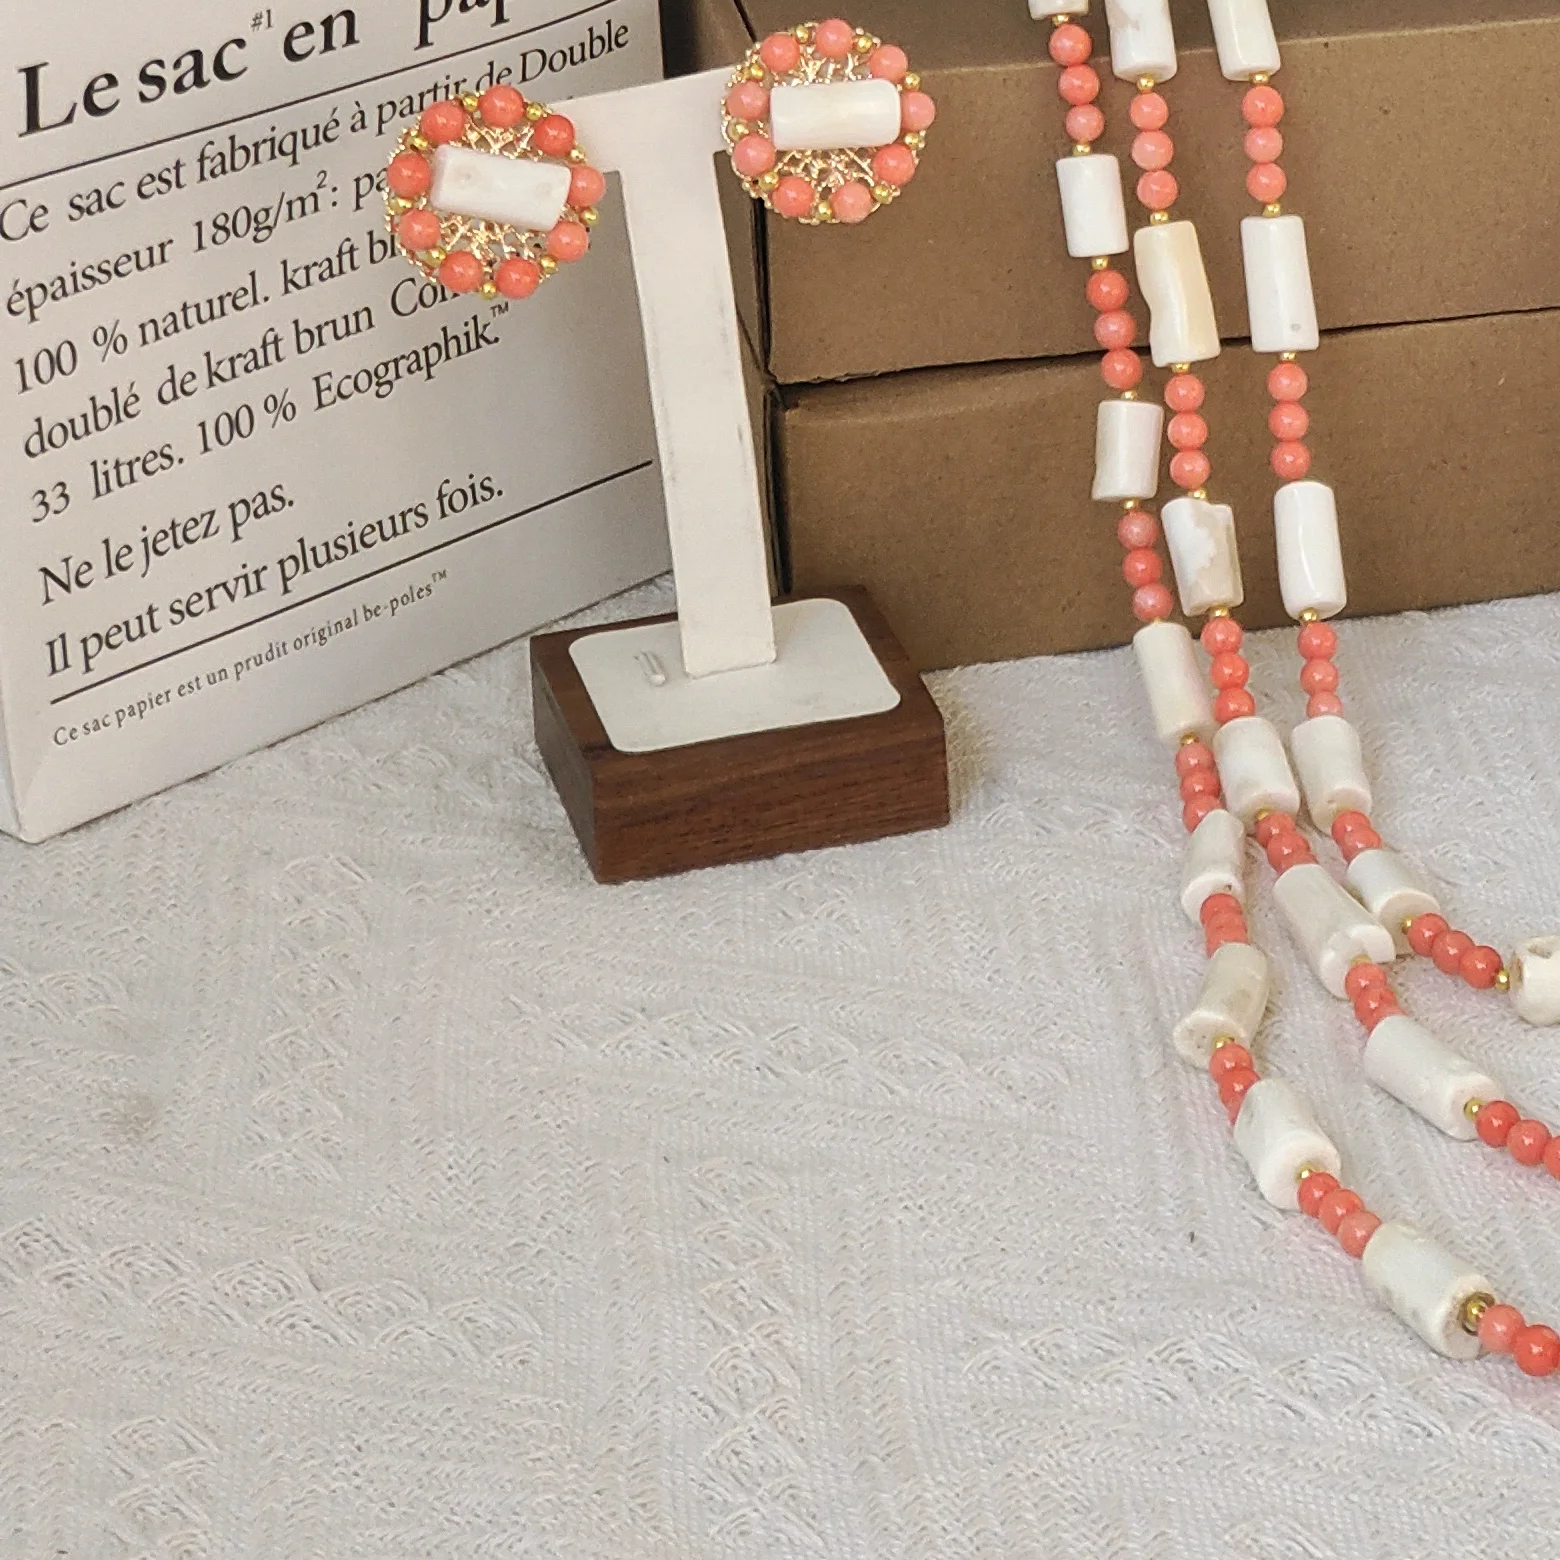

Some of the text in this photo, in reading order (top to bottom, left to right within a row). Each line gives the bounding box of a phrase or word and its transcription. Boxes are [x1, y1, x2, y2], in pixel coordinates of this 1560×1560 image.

[0, 198, 49, 241] Ce
[68, 181, 126, 222] sac
[137, 158, 187, 200] est
[197, 107, 340, 183] fabriqué
[350, 101, 367, 133] à
[518, 18, 630, 84] Double
[18, 62, 120, 137] Le
[283, 8, 360, 63] en
[7, 239, 173, 325] épaisseur
[15, 340, 78, 394] 100
[139, 270, 269, 348] naturel.
[281, 236, 360, 296] kraft
[24, 306, 375, 458] doublé de kraft brun
[31, 481, 70, 523] 33
[90, 443, 184, 500] litres.
[198, 404, 255, 455] 100
[38, 483, 294, 606] Ne le jetez pas.
[45, 473, 504, 676] Il peut servir plusieurs fois.
[53, 726, 78, 746] Ce
[83, 713, 111, 736] sac
[115, 688, 172, 729] papier
[177, 676, 203, 697] est
[206, 666, 228, 686] un
[233, 642, 289, 681] prudit
[293, 609, 359, 651] original
